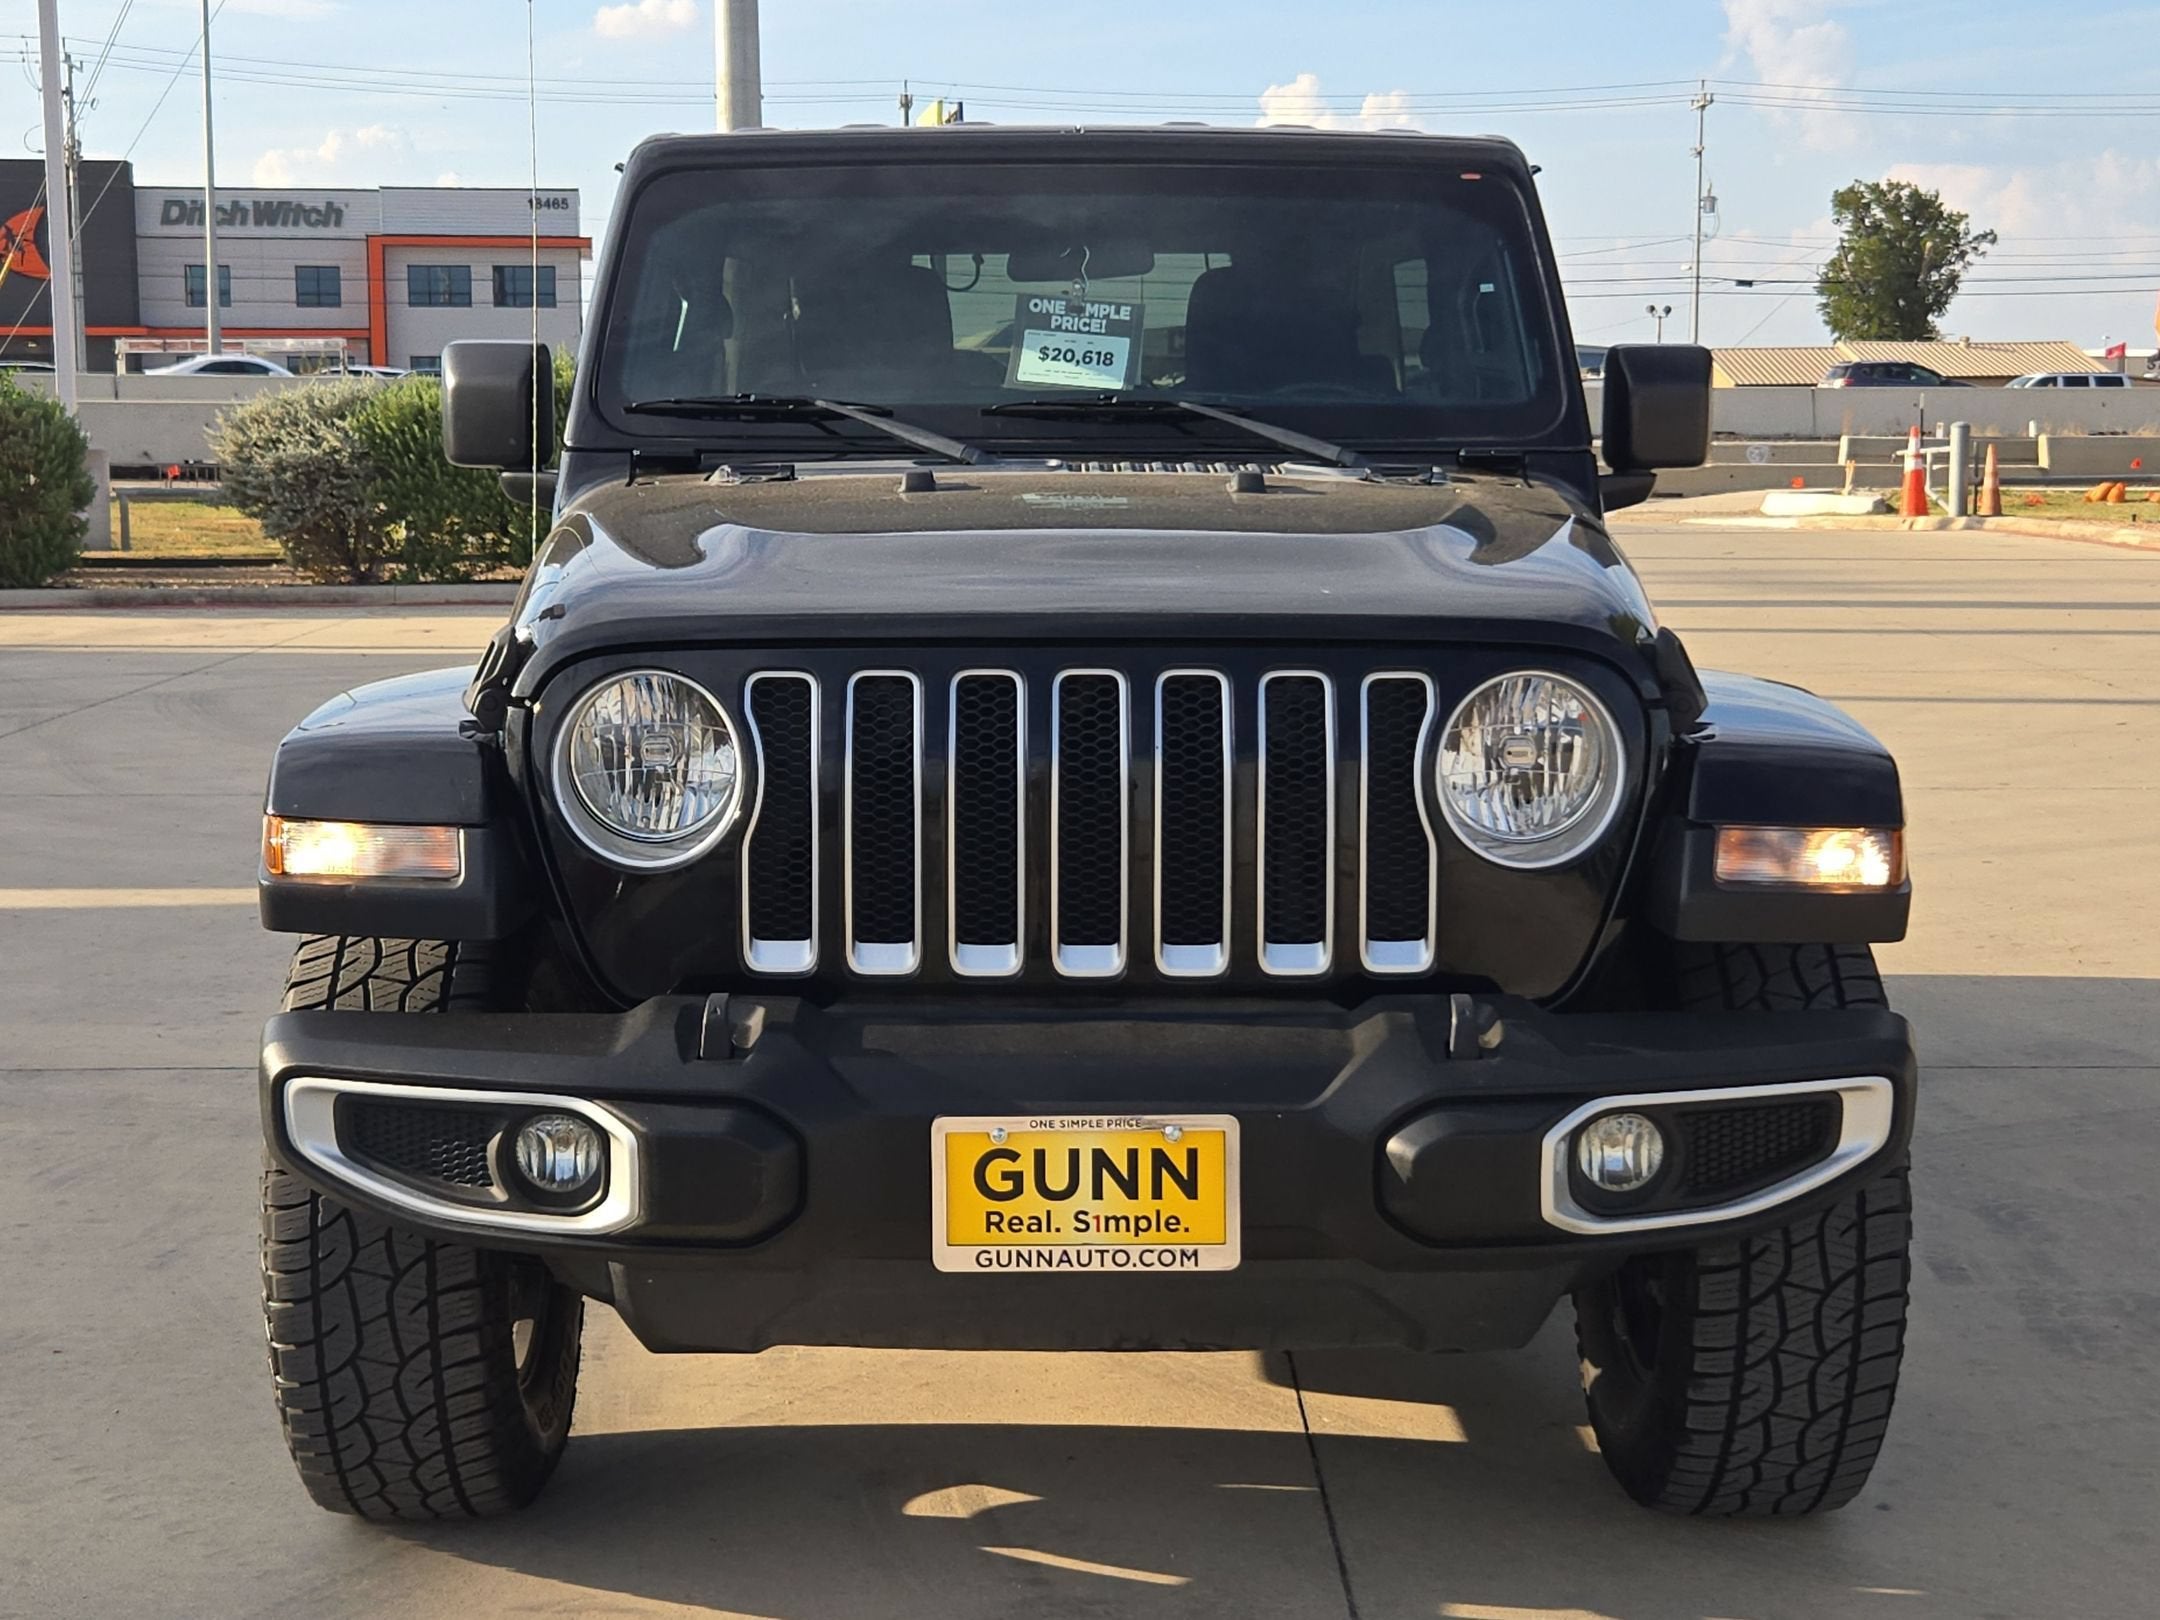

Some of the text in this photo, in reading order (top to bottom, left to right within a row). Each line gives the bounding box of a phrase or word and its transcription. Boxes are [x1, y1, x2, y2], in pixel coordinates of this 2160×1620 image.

[252, 200, 344, 228] Witch
[1028, 298, 1132, 320] ONE MPLE
[1050, 315, 1107, 333] PRICE!
[1038, 346, 1114, 367] $20,618
[1029, 1118, 1142, 1130] ONE SIMPLE PRICE
[973, 1147, 1199, 1202] GUNN
[984, 1209, 1062, 1233] Real.
[975, 1249, 1199, 1268] GUNNAUTO.COM
